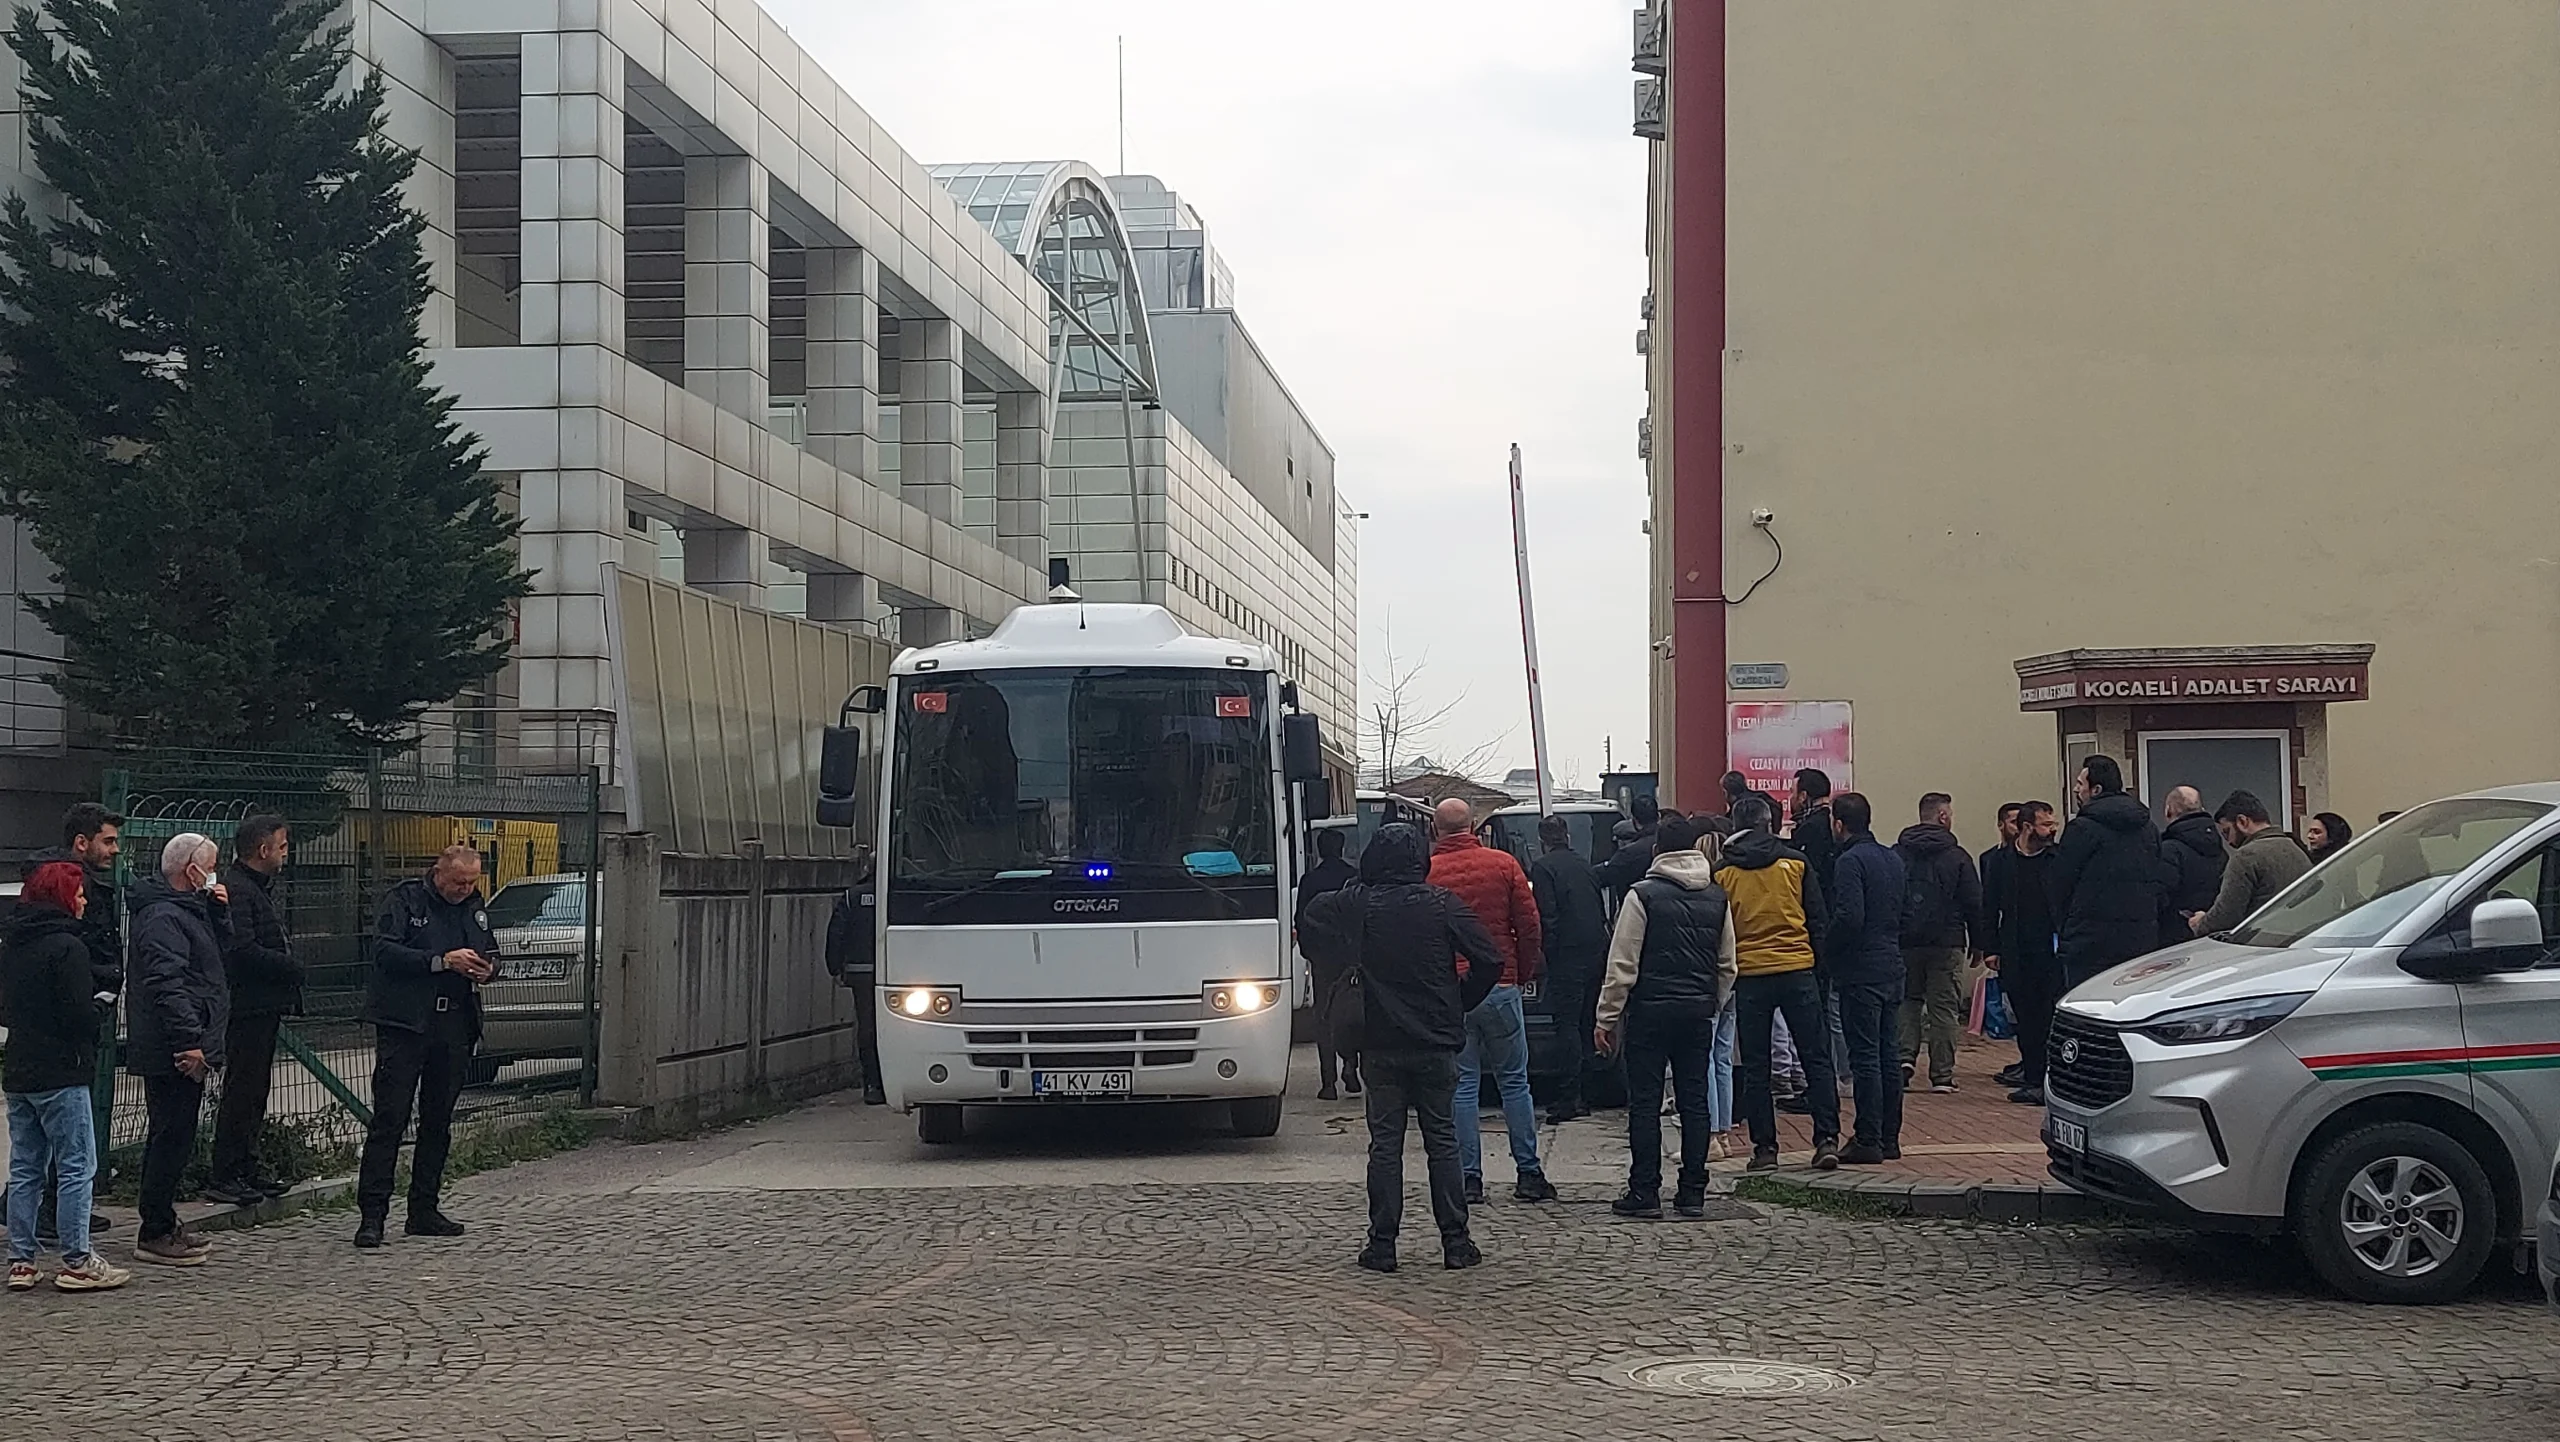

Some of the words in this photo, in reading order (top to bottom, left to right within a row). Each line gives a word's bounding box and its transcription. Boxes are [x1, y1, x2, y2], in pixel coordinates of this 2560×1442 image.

[2084, 675, 2178, 697] KOCAELİ
[2184, 678, 2271, 696] ADALET
[2276, 676, 2357, 693] SARAYI
[1054, 899, 1119, 912] OTOKAR
[1043, 1074, 1057, 1090] 41
[1068, 1074, 1090, 1090] KV
[1101, 1073, 1126, 1089] 491
